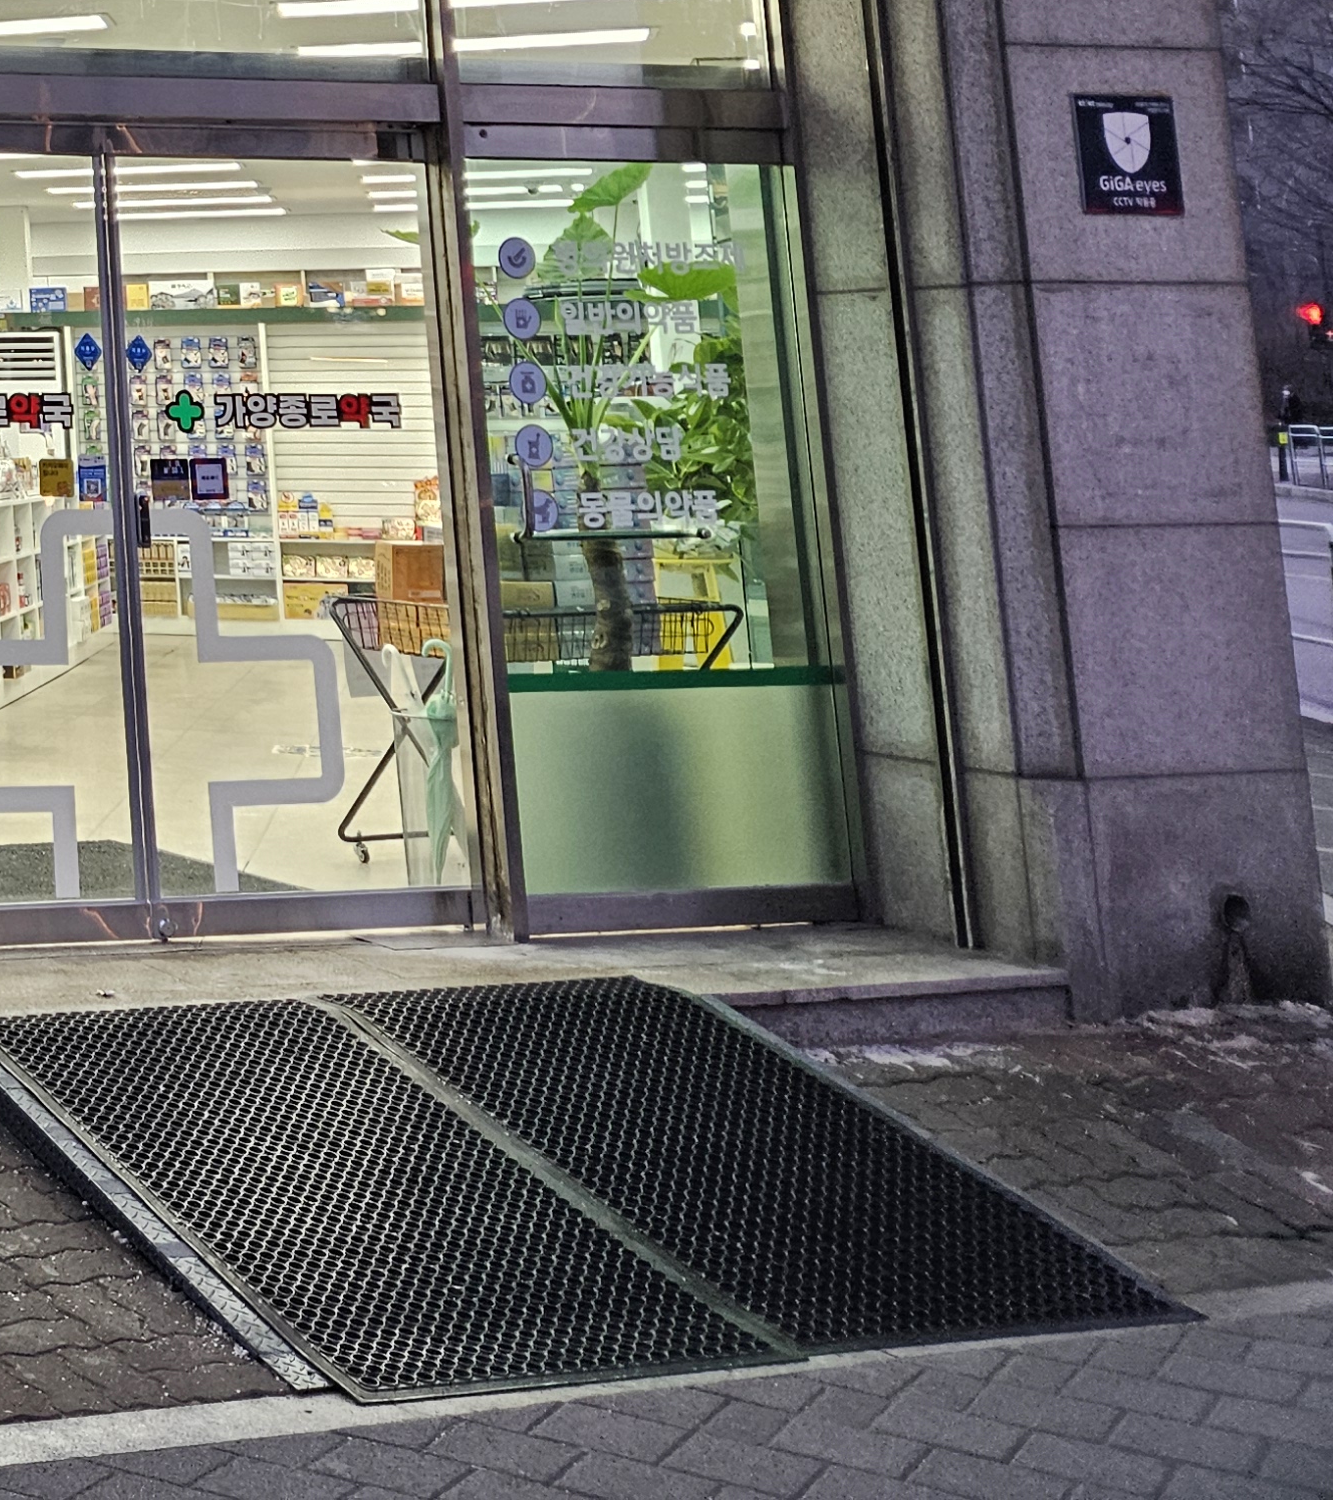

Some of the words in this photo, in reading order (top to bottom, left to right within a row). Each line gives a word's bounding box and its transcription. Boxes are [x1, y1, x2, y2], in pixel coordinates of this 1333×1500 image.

[1099, 175, 1134, 191] GiGA
[1136, 180, 1167, 195] eyes
[560, 300, 698, 336] 일반의약품
[213, 393, 403, 429] 가양종로약국
[571, 427, 684, 462] 건강상담
[578, 490, 719, 529] 동물의약품
